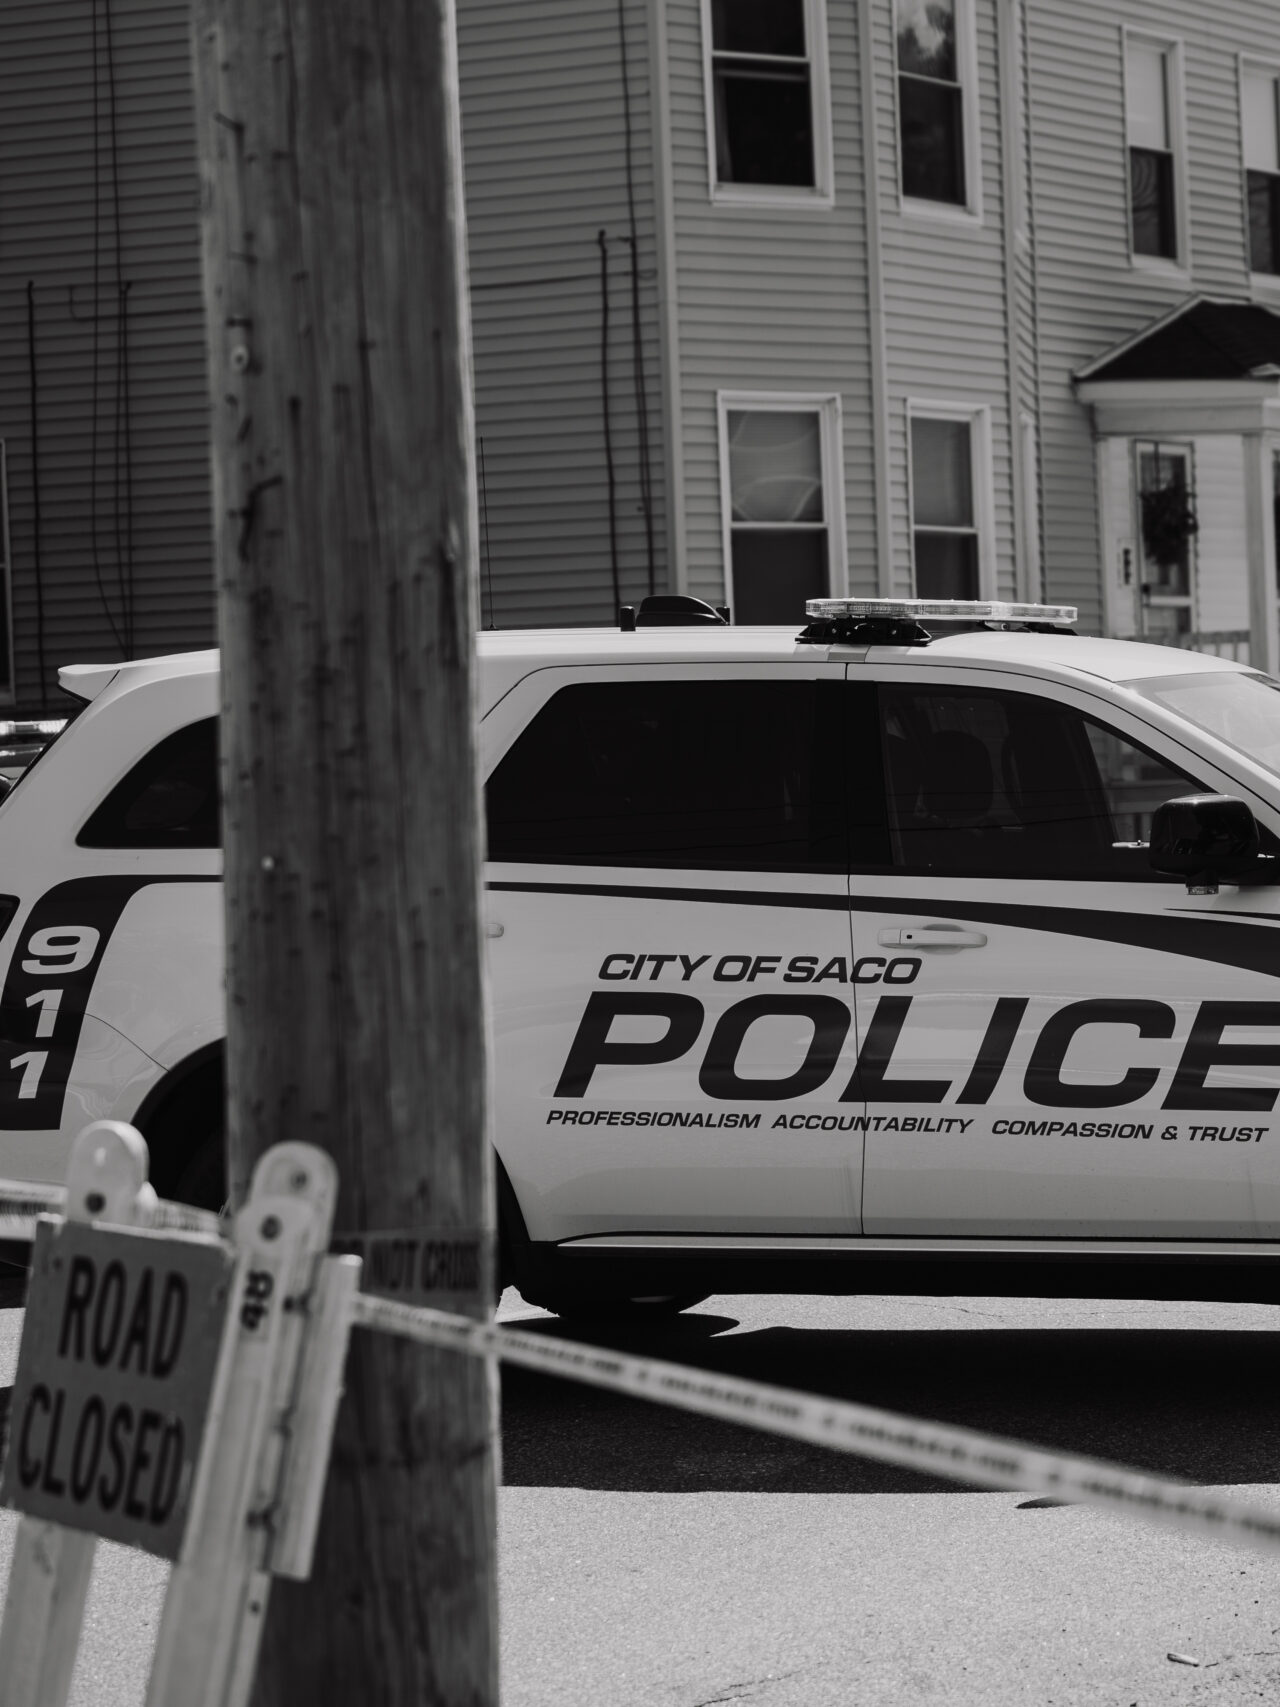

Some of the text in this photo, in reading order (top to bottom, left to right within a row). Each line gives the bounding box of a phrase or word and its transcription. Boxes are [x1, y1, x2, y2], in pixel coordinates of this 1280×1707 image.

[598, 953, 923, 984] CITY OF SACO
[546, 1110, 1270, 1143] PROFESSIONALISM ACCOUNTABILITY COMPASSION & TRUST
[57, 1254, 189, 1380] ROAD
[17, 1382, 186, 1526] CLOSED
